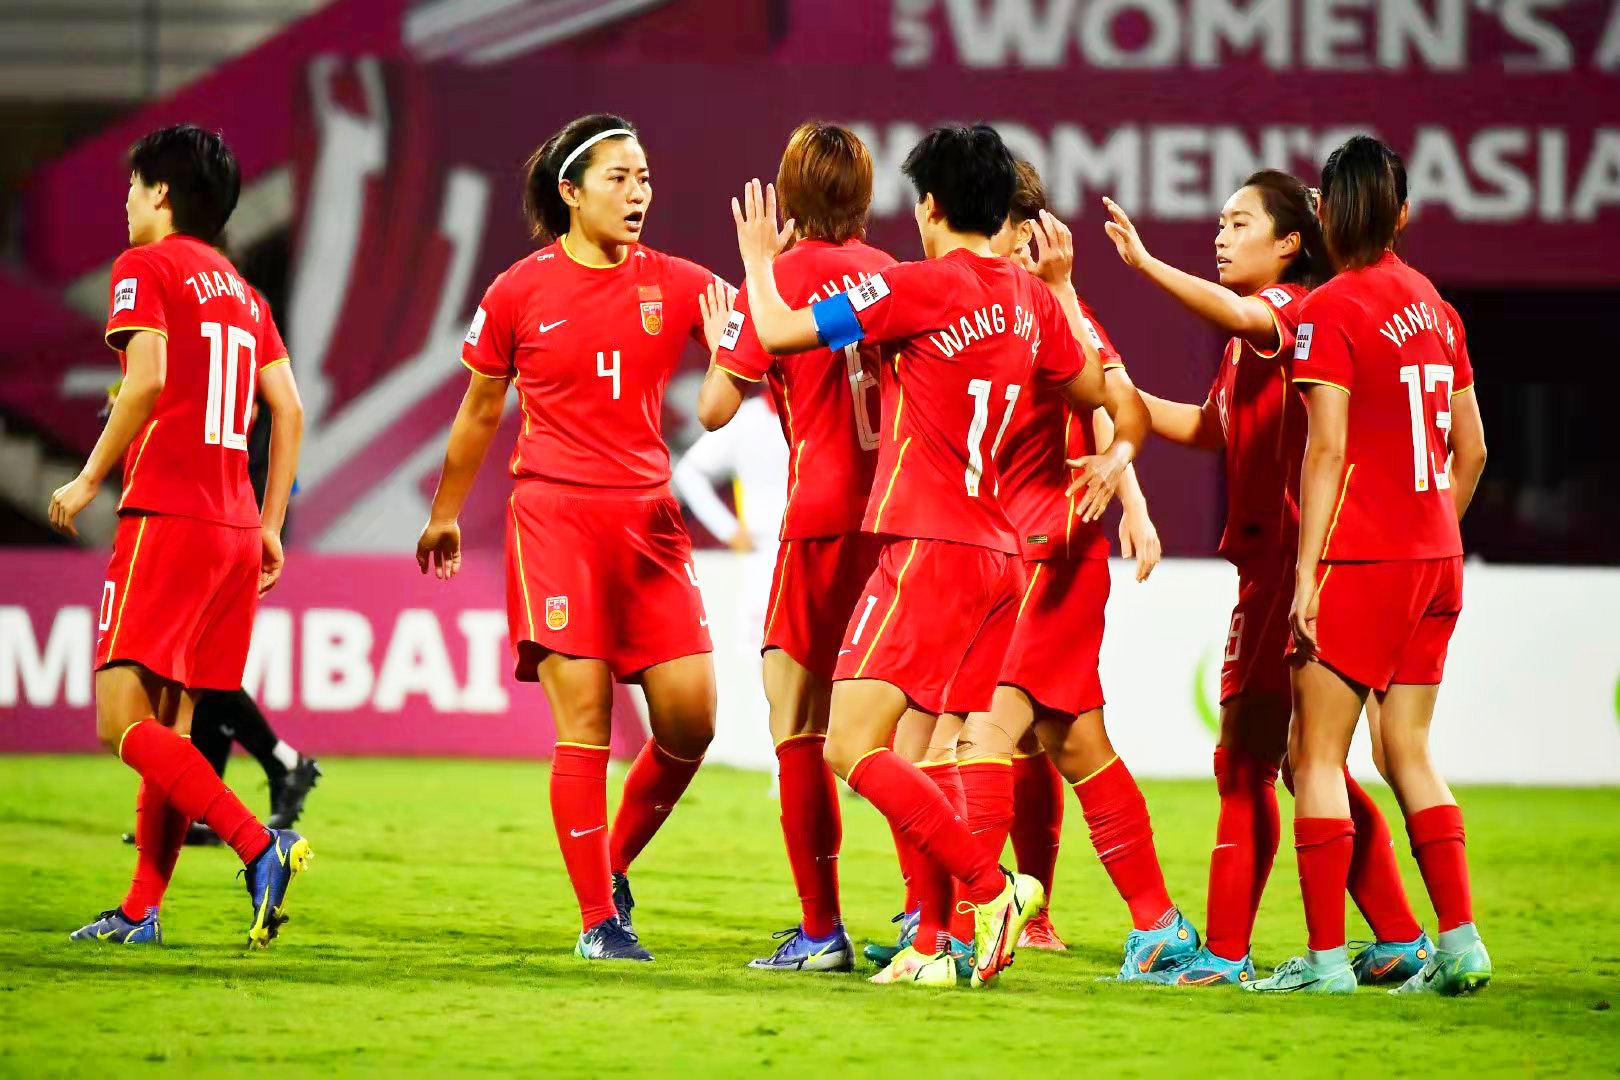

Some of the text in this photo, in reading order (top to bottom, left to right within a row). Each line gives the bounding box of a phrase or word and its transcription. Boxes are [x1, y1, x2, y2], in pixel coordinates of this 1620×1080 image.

[944, 0, 1574, 70] WOMEN'S
[850, 122, 1376, 222] WMEN'
[185, 270, 246, 304] ZHANG
[1380, 301, 1433, 348] YANG
[929, 303, 1006, 358] WANG
[200, 321, 258, 450] 10
[596, 350, 621, 400] 4
[964, 378, 1022, 499] 11
[1399, 363, 1455, 492] 13
[0, 604, 509, 714] MMBAI
